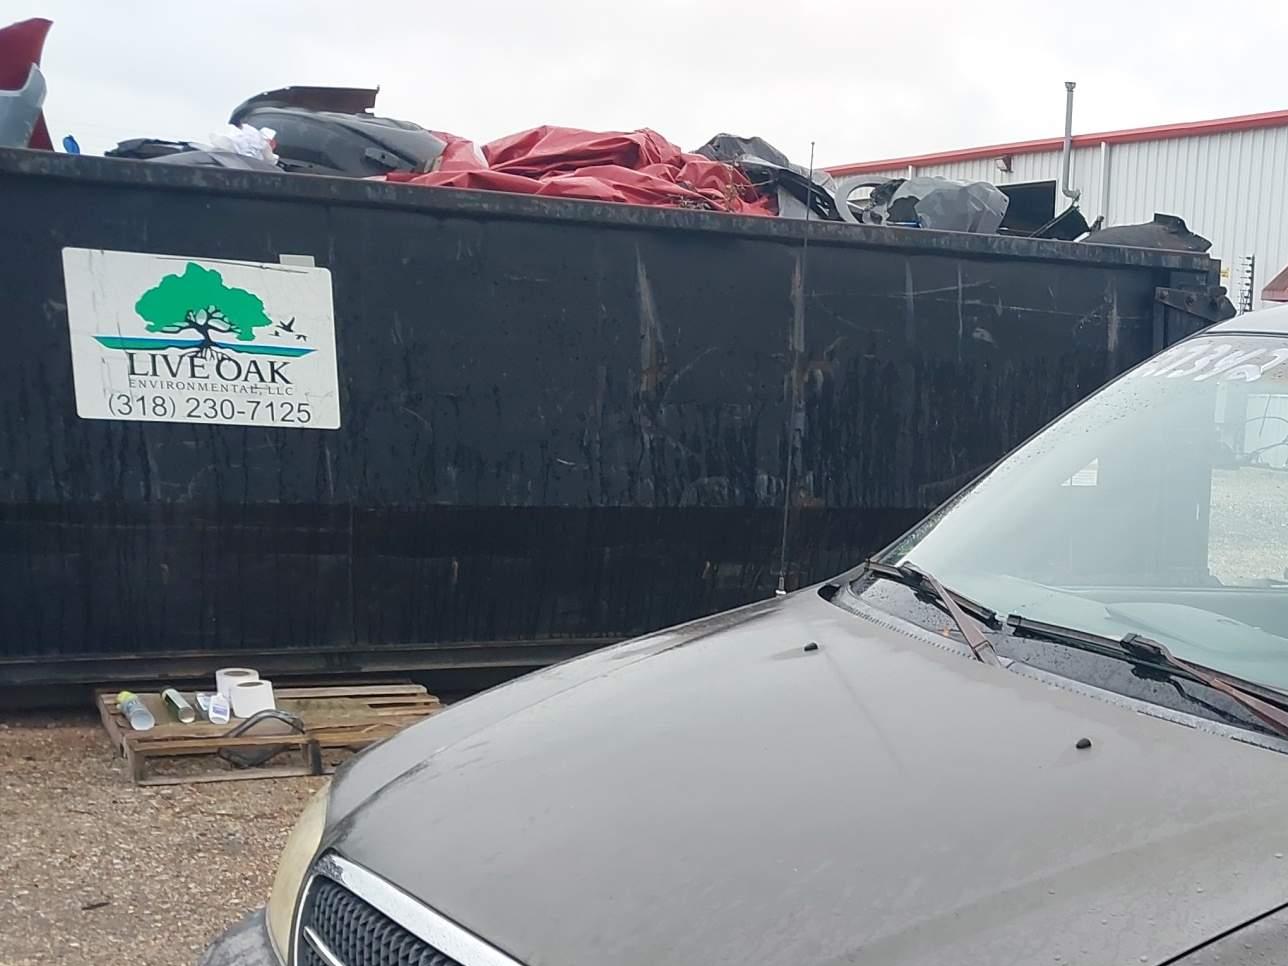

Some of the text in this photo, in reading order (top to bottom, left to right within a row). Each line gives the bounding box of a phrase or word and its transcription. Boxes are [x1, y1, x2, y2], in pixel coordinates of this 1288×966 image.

[127, 351, 292, 385] LIVE OAK
[267, 386, 294, 396] LLC
[109, 393, 312, 424] (318) 230-7125
